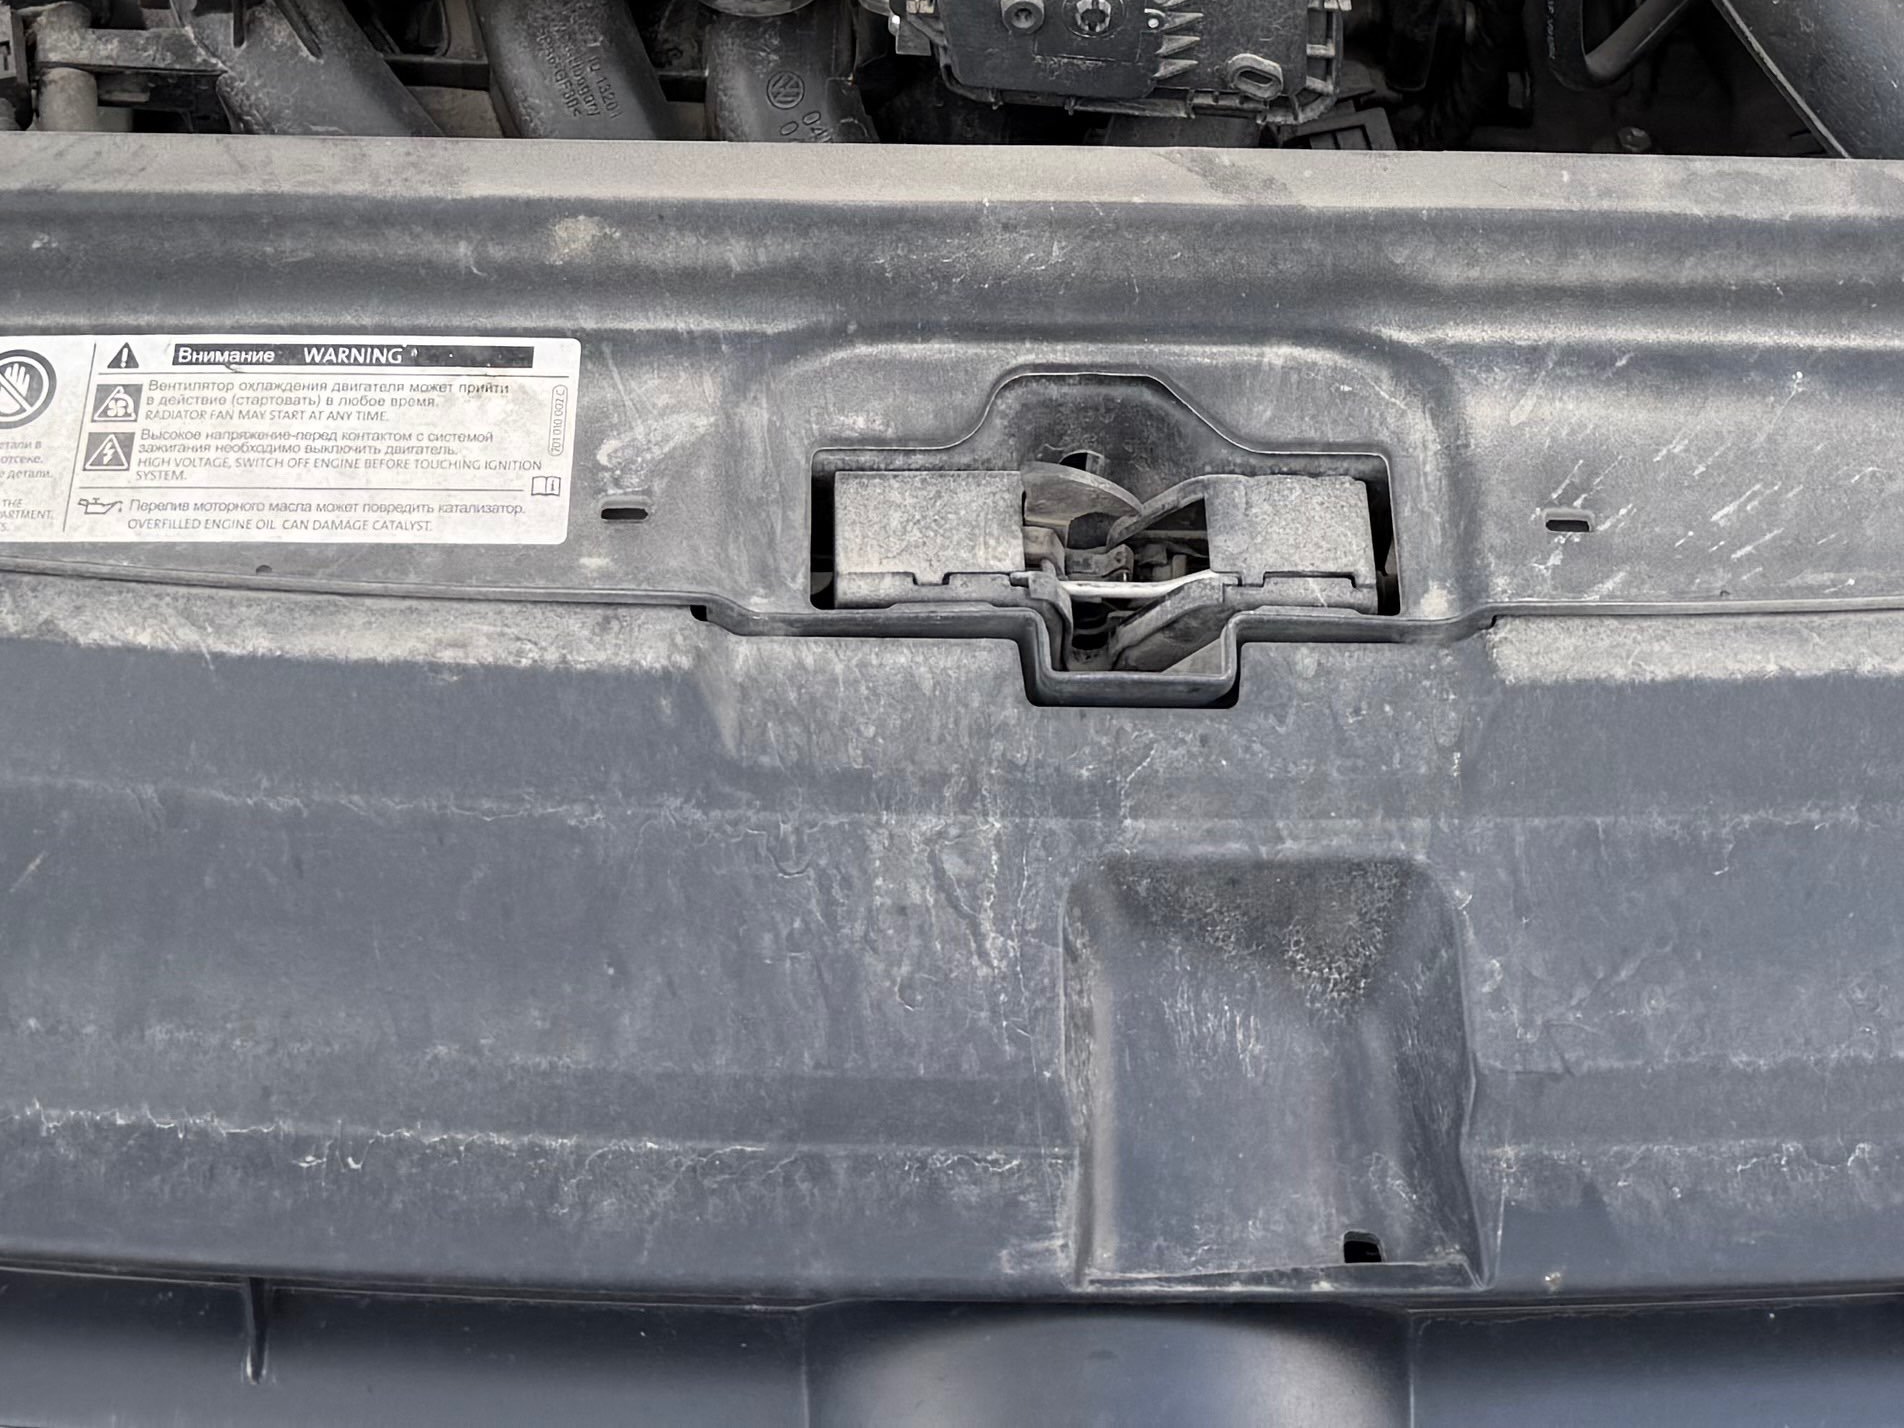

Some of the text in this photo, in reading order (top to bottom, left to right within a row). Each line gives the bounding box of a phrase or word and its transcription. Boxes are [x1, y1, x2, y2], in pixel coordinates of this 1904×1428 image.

[177, 347, 275, 363] Внимание
[303, 347, 403, 364] WARNING
[148, 379, 509, 395] Вентилятор охлаждения двигателя может прийти
[147, 394, 439, 410] в действие (стартовать) в любое время.
[145, 409, 389, 422] RADIATOR FAN MAY START AT ANY TIME.
[140, 429, 201, 441] Высокое
[205, 430, 337, 443] напряжение-перед
[341, 432, 412, 442] контактом
[427, 431, 493, 443] системой
[138, 442, 458, 456] зажигания необходимо выключить двигатель.
[0, 455, 44, 465] отсеке.
[137, 458, 542, 471] HIGH VOLTAGE, SWITCH OFF ENGINE BEFORE TOUCHING IGNITION
[7, 470, 53, 480] детали.
[136, 470, 187, 481] SYSTEM.
[2, 499, 23, 508] THE
[129, 499, 526, 515] Перелив моторного масла может повредить катализатор.
[127, 519, 433, 532] OVERFILLED ENGINE OIL CAN DAMAGE CATALYST.
